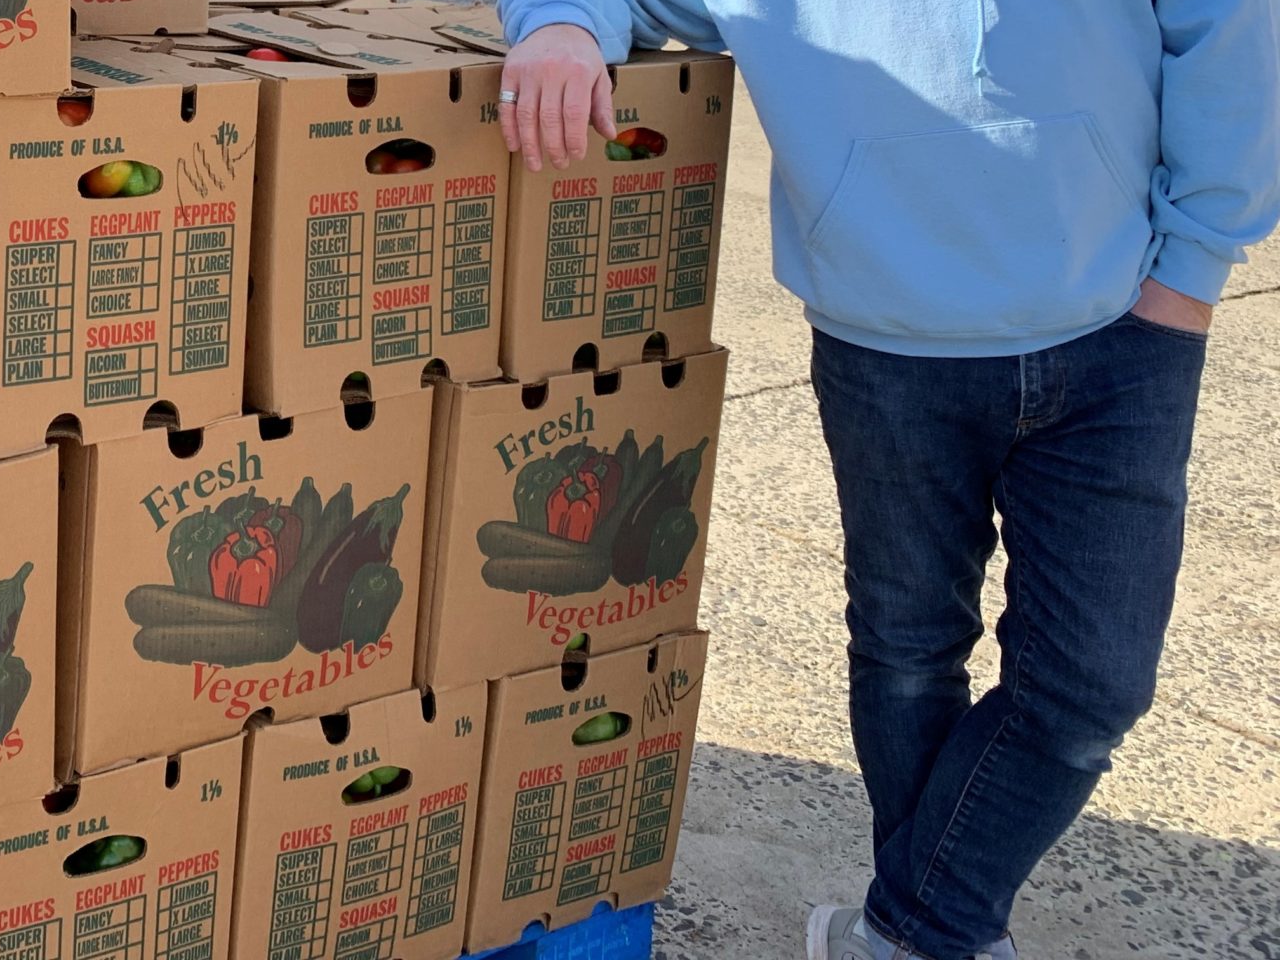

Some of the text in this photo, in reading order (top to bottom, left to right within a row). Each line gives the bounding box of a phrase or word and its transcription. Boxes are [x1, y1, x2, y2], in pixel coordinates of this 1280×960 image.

[615, 108, 639, 124] U.S.A.
[309, 116, 403, 139] PRODUCE OF U.S.A.
[9, 137, 125, 160] PRODUCE OF U.S.A.
[612, 171, 665, 194] EGGPLANT
[673, 163, 718, 185] PEPPERS
[375, 183, 434, 208] EGGPLANT
[444, 174, 496, 199] PEPPERS
[552, 177, 597, 199] CUKES
[309, 190, 359, 215] CUKES
[457, 202, 487, 220] JUMBO
[553, 202, 586, 220] SUPER
[90, 210, 161, 237] EGGPLANT
[174, 201, 236, 228] PEPPERS
[378, 213, 407, 231] FANCY
[9, 216, 69, 244] CUKES
[310, 218, 347, 237] SUPER
[551, 219, 585, 237] SELECT
[92, 241, 129, 261] FANCY
[189, 231, 226, 251] JUMBO
[310, 236, 347, 255] SELECT
[550, 240, 580, 257] SMALL
[10, 246, 56, 267] SUPER
[188, 253, 230, 274] X LARGE
[456, 246, 482, 263] LARGE
[9, 265, 55, 287] SELECT
[91, 266, 140, 287] LARGE FANCY
[309, 259, 342, 277] SMALL
[376, 260, 410, 279] CHOICE
[549, 259, 583, 277] SELECT
[606, 265, 657, 289] SQUASH
[187, 278, 220, 297] LARGE
[308, 280, 345, 299] SELECT
[372, 284, 430, 311] SQUASH
[454, 289, 484, 308] SELECT
[547, 280, 577, 297] LARGE
[9, 290, 49, 310] SMALL
[91, 293, 131, 313] CHOICE
[308, 302, 340, 320] LARGE
[187, 301, 228, 322] MEDIUM
[8, 312, 54, 334] SELECT
[308, 323, 337, 343] PLAIN
[375, 315, 405, 334] ACORN
[86, 320, 156, 349] SQUASH
[186, 325, 224, 345] SELECT
[8, 337, 46, 357] LARGE
[185, 346, 225, 368] SUNTAN
[7, 361, 43, 382] PLAIN
[89, 353, 126, 373] ACORN
[88, 377, 138, 400] BUTTERNUT
[493, 396, 595, 475] Fresh
[139, 440, 264, 533] Fresh
[526, 570, 689, 646] Vegetables
[191, 632, 394, 720] Vegetables
[524, 694, 608, 725] PRODUCE OF U.S.A.
[637, 732, 682, 758] PEPPERS
[283, 747, 380, 782] PRODUCE OF U.S.A.
[577, 748, 628, 776] EGGPLANT
[518, 764, 563, 789] CUKES
[419, 782, 468, 814] PEPPERS
[349, 805, 409, 837] EGGPLANT
[516, 804, 550, 823] SELECT
[56, 824, 71, 842] OF
[77, 816, 110, 837] U.S.A.
[280, 824, 332, 852] CUKES
[566, 834, 616, 862] SQUASH
[158, 849, 219, 886] PEPPERS
[280, 851, 319, 872] SUPER
[279, 867, 318, 889] SELECT
[75, 874, 145, 911] EGGPLANT
[173, 879, 209, 905] JUMBO
[277, 888, 311, 908] SMALL
[78, 909, 114, 934] FANCY
[275, 905, 314, 927] SELECT
[339, 896, 398, 929] SQUASH
[171, 923, 203, 947] LARGE
[273, 926, 306, 947] LARGE
